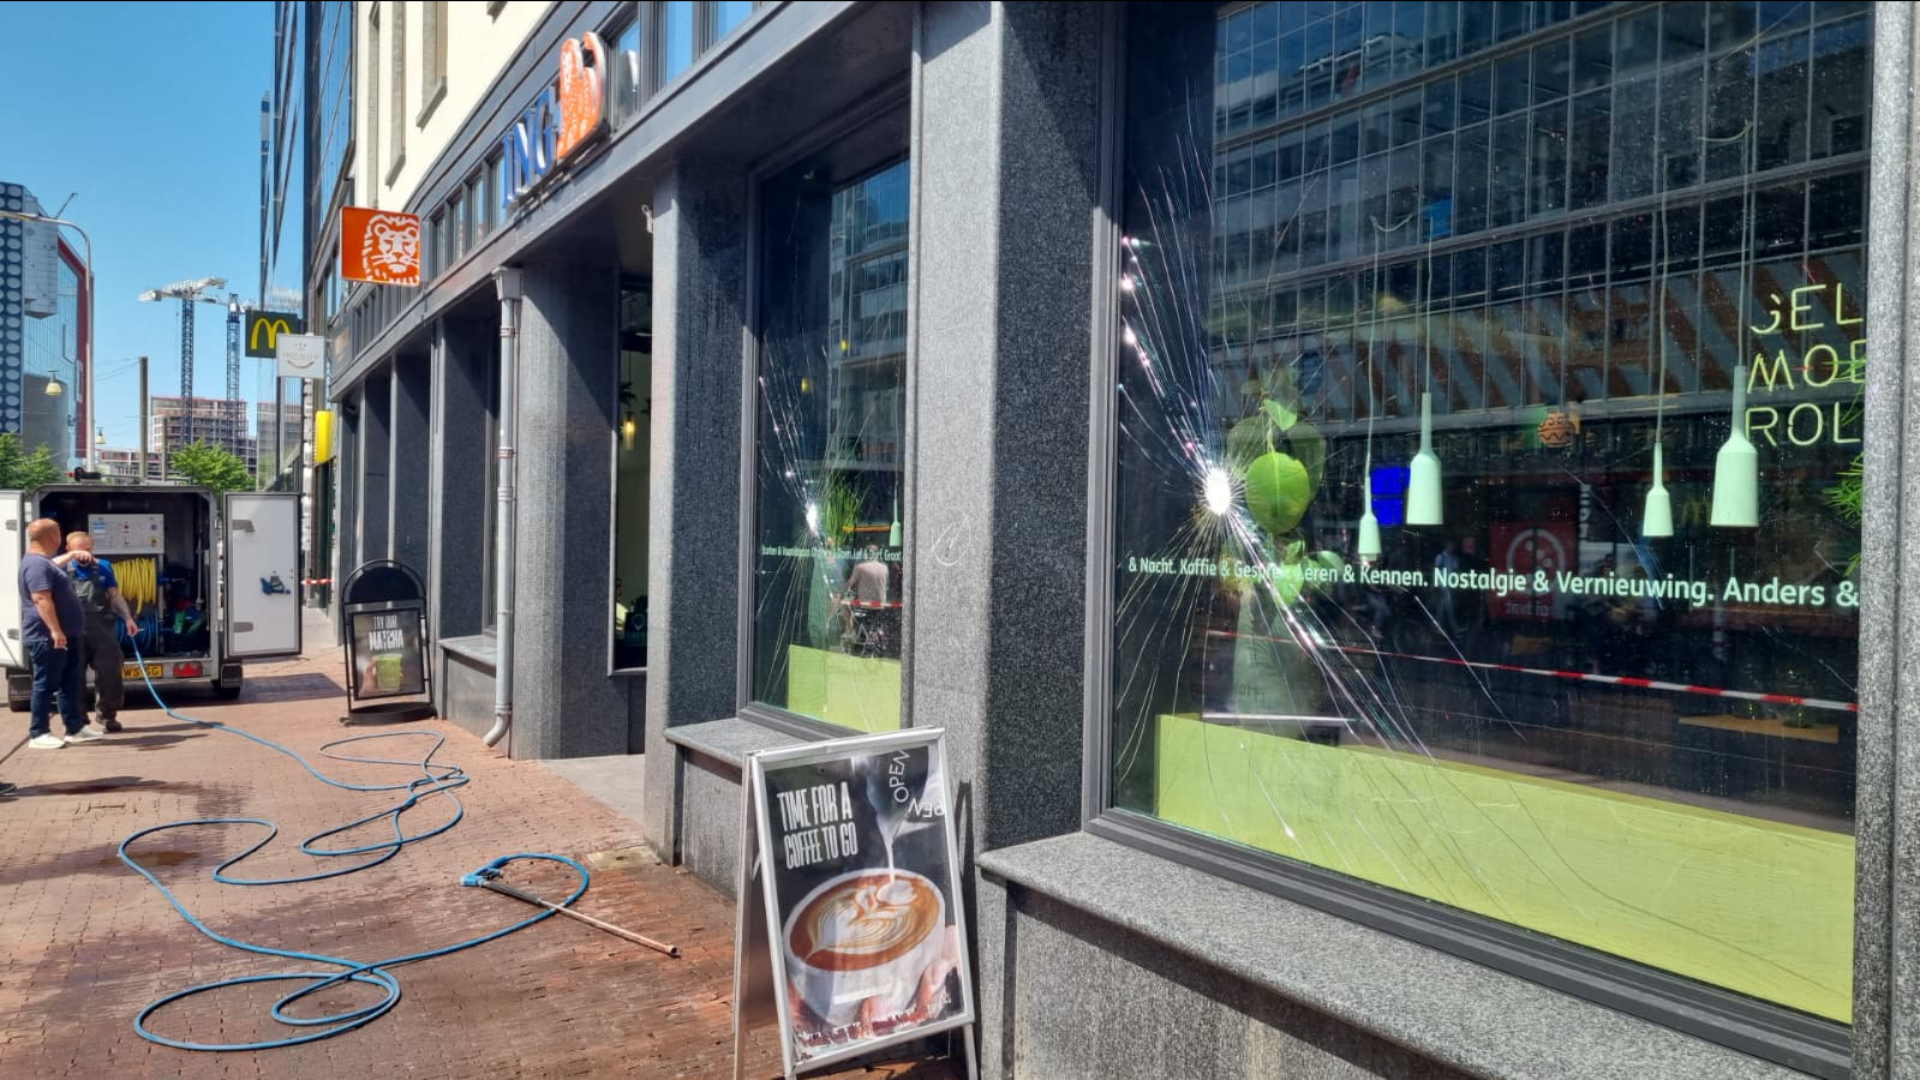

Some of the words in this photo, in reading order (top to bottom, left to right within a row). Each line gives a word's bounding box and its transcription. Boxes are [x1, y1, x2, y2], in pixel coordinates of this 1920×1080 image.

[502, 86, 558, 209] ING
[1128, 557, 1137, 573] &
[1140, 557, 1177, 574] Nacht.
[1180, 558, 1217, 577] Koffie
[1220, 559, 1231, 578] &
[1343, 564, 1355, 583] &
[1360, 565, 1428, 588] Kennen.
[1434, 567, 1526, 597] Nostalgie
[1533, 570, 1549, 593] &
[1556, 571, 1714, 607] Vernieuwing.
[1723, 576, 1825, 606] Anders
[1836, 580, 1860, 607] &
[889, 750, 911, 804] OPEN
[776, 787, 809, 832] TIME
[811, 783, 839, 825] FOR
[840, 781, 853, 820] A
[907, 797, 946, 818] PEN
[783, 828, 824, 870] COFFEE
[821, 825, 839, 860] TO
[840, 822, 858, 858] GO
